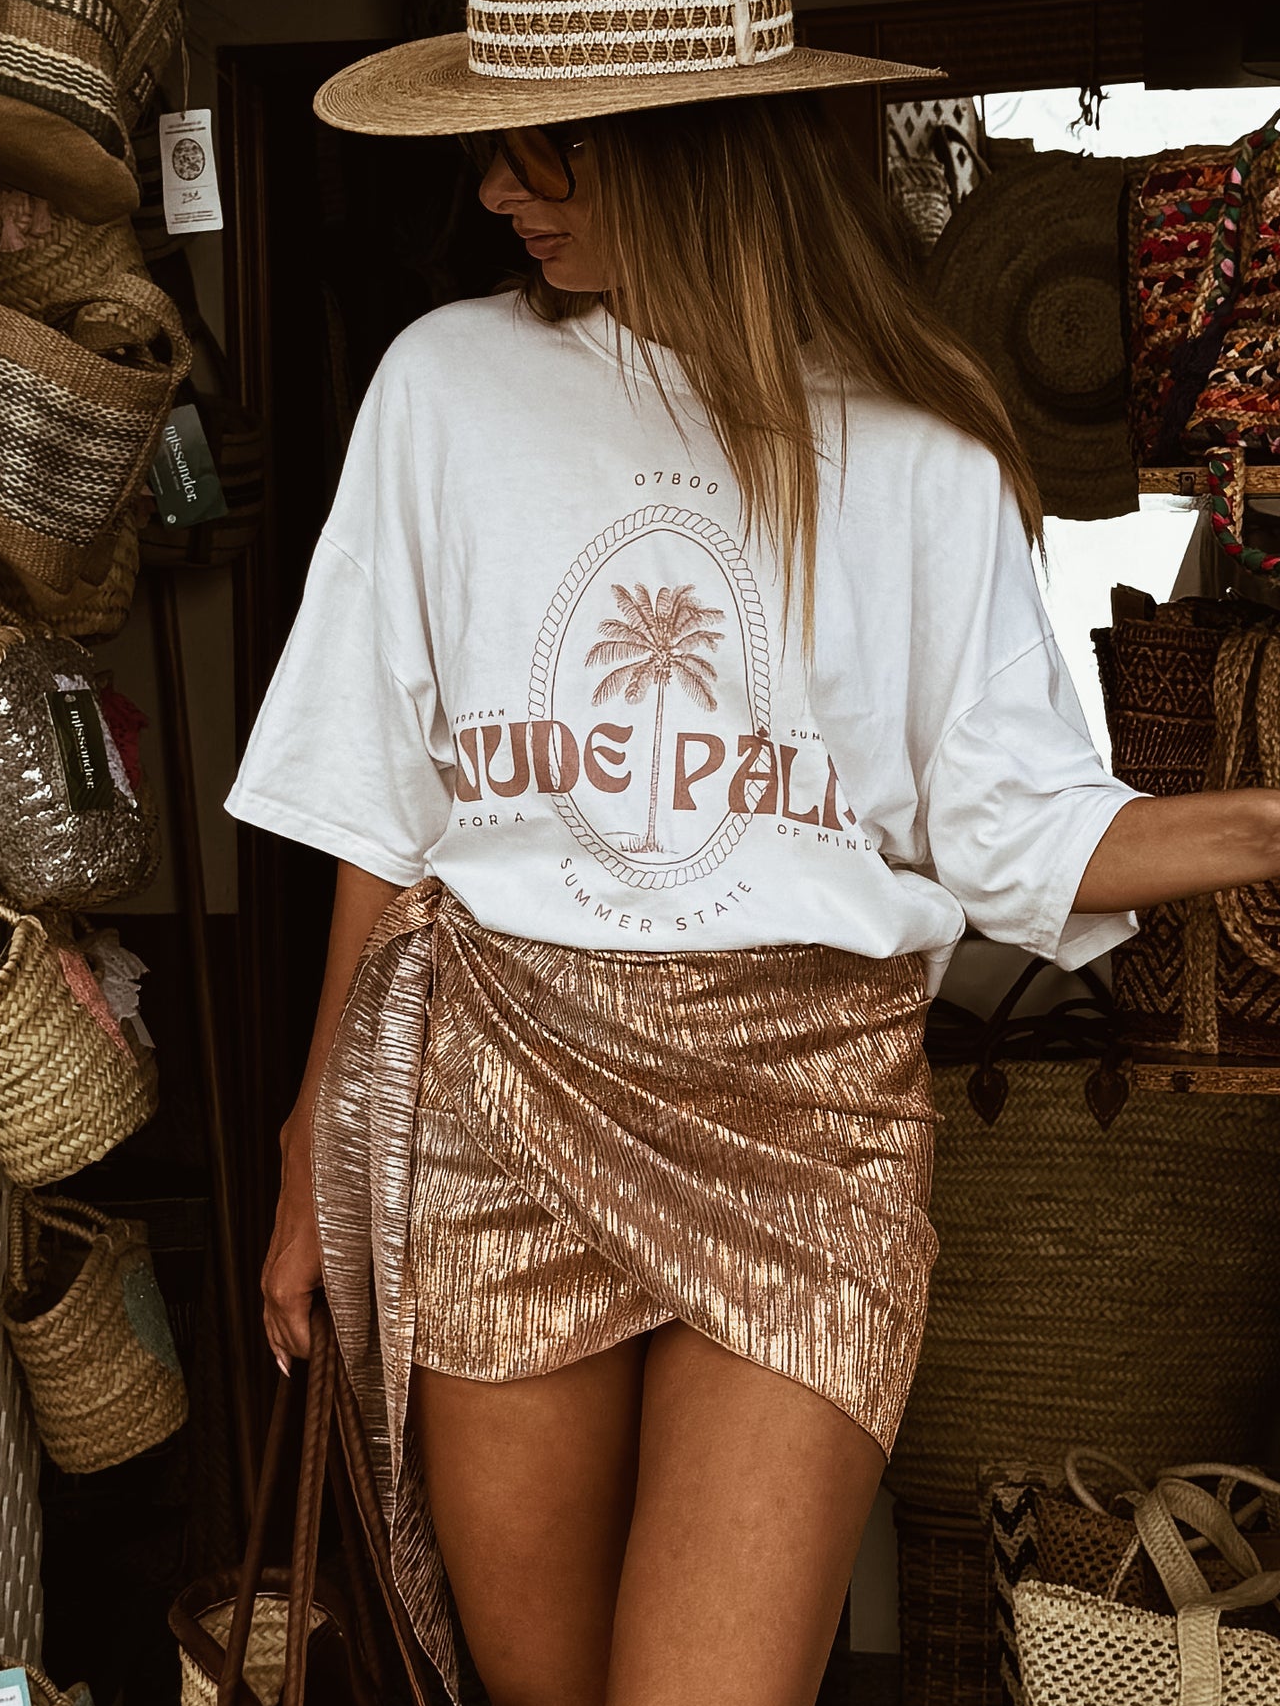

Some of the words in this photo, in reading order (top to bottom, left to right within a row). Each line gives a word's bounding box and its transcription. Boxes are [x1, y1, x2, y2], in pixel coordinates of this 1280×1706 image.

[634, 471, 719, 495] 07800
[452, 721, 634, 802] NUDE
[459, 814, 499, 829] FOR
[514, 812, 526, 823] A
[777, 824, 801, 838] OF
[817, 832, 872, 851] MIND
[560, 857, 653, 934] SUMMER
[675, 881, 752, 931] STATE
